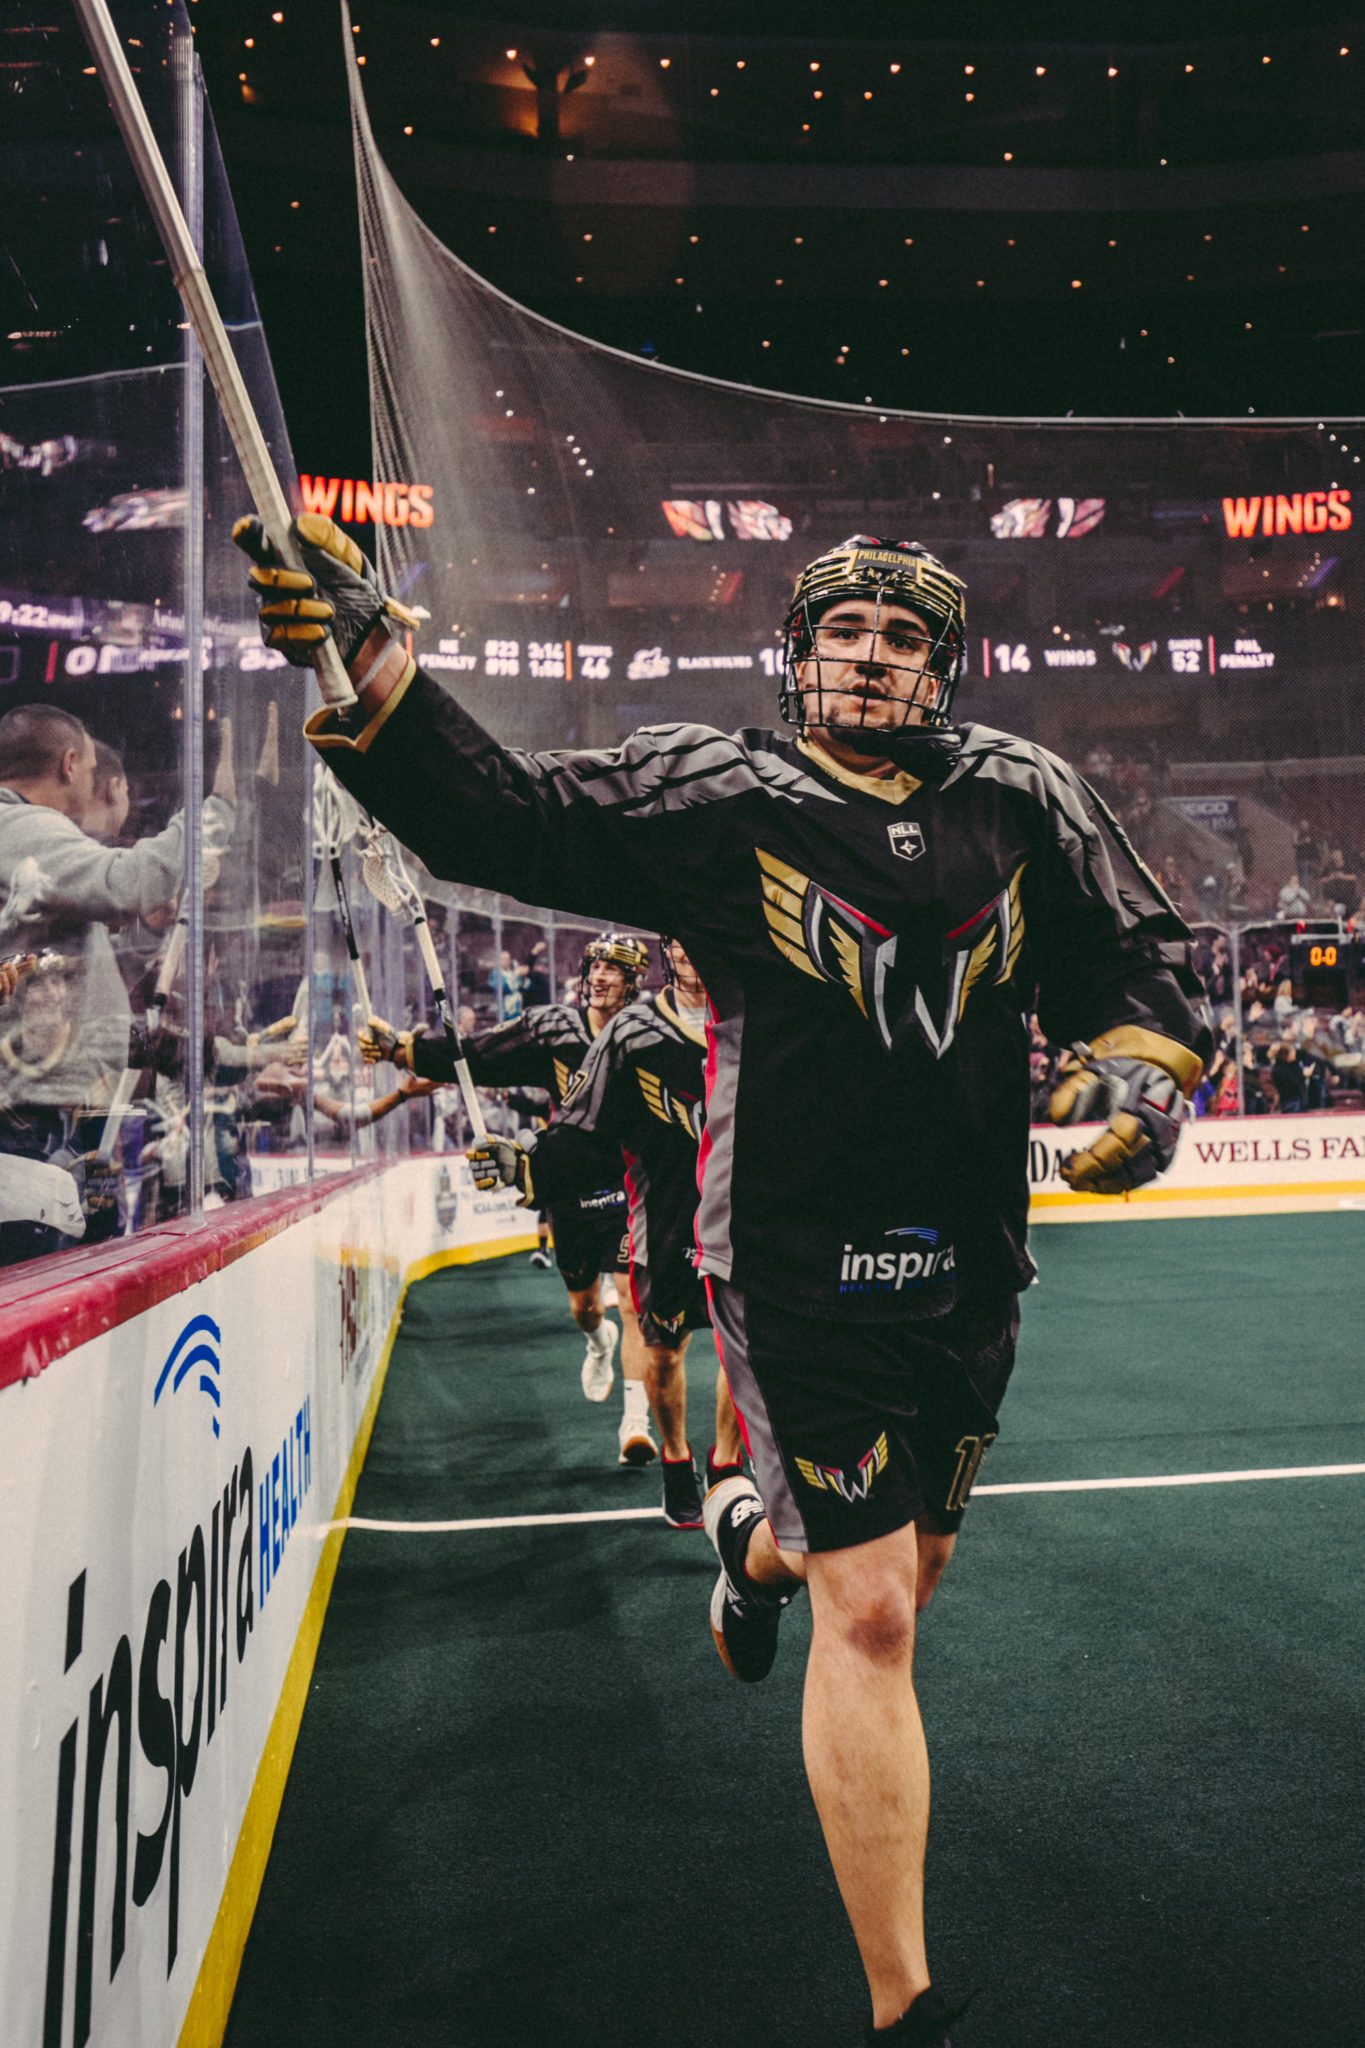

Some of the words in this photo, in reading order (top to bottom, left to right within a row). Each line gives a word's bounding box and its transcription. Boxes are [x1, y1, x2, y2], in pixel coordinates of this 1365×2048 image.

[300, 474, 435, 528] WINGS
[1222, 490, 1352, 538] WINGS
[858, 550, 917, 568] PHILADELPHIA
[994, 643, 1031, 673] 14
[1043, 648, 1097, 667] WINGS
[1168, 638, 1203, 653] SHOTS
[418, 653, 477, 671] PENALTY
[1171, 651, 1200, 673] 52
[1219, 652, 1275, 669] PENALTY
[891, 824, 918, 835] NLL
[1195, 1138, 1311, 1163] WELLS
[1320, 1136, 1365, 1159] FA
[841, 1244, 955, 1290] inspira
[258, 1393, 311, 1612] HEALTH
[43, 1446, 254, 2048] inspira
